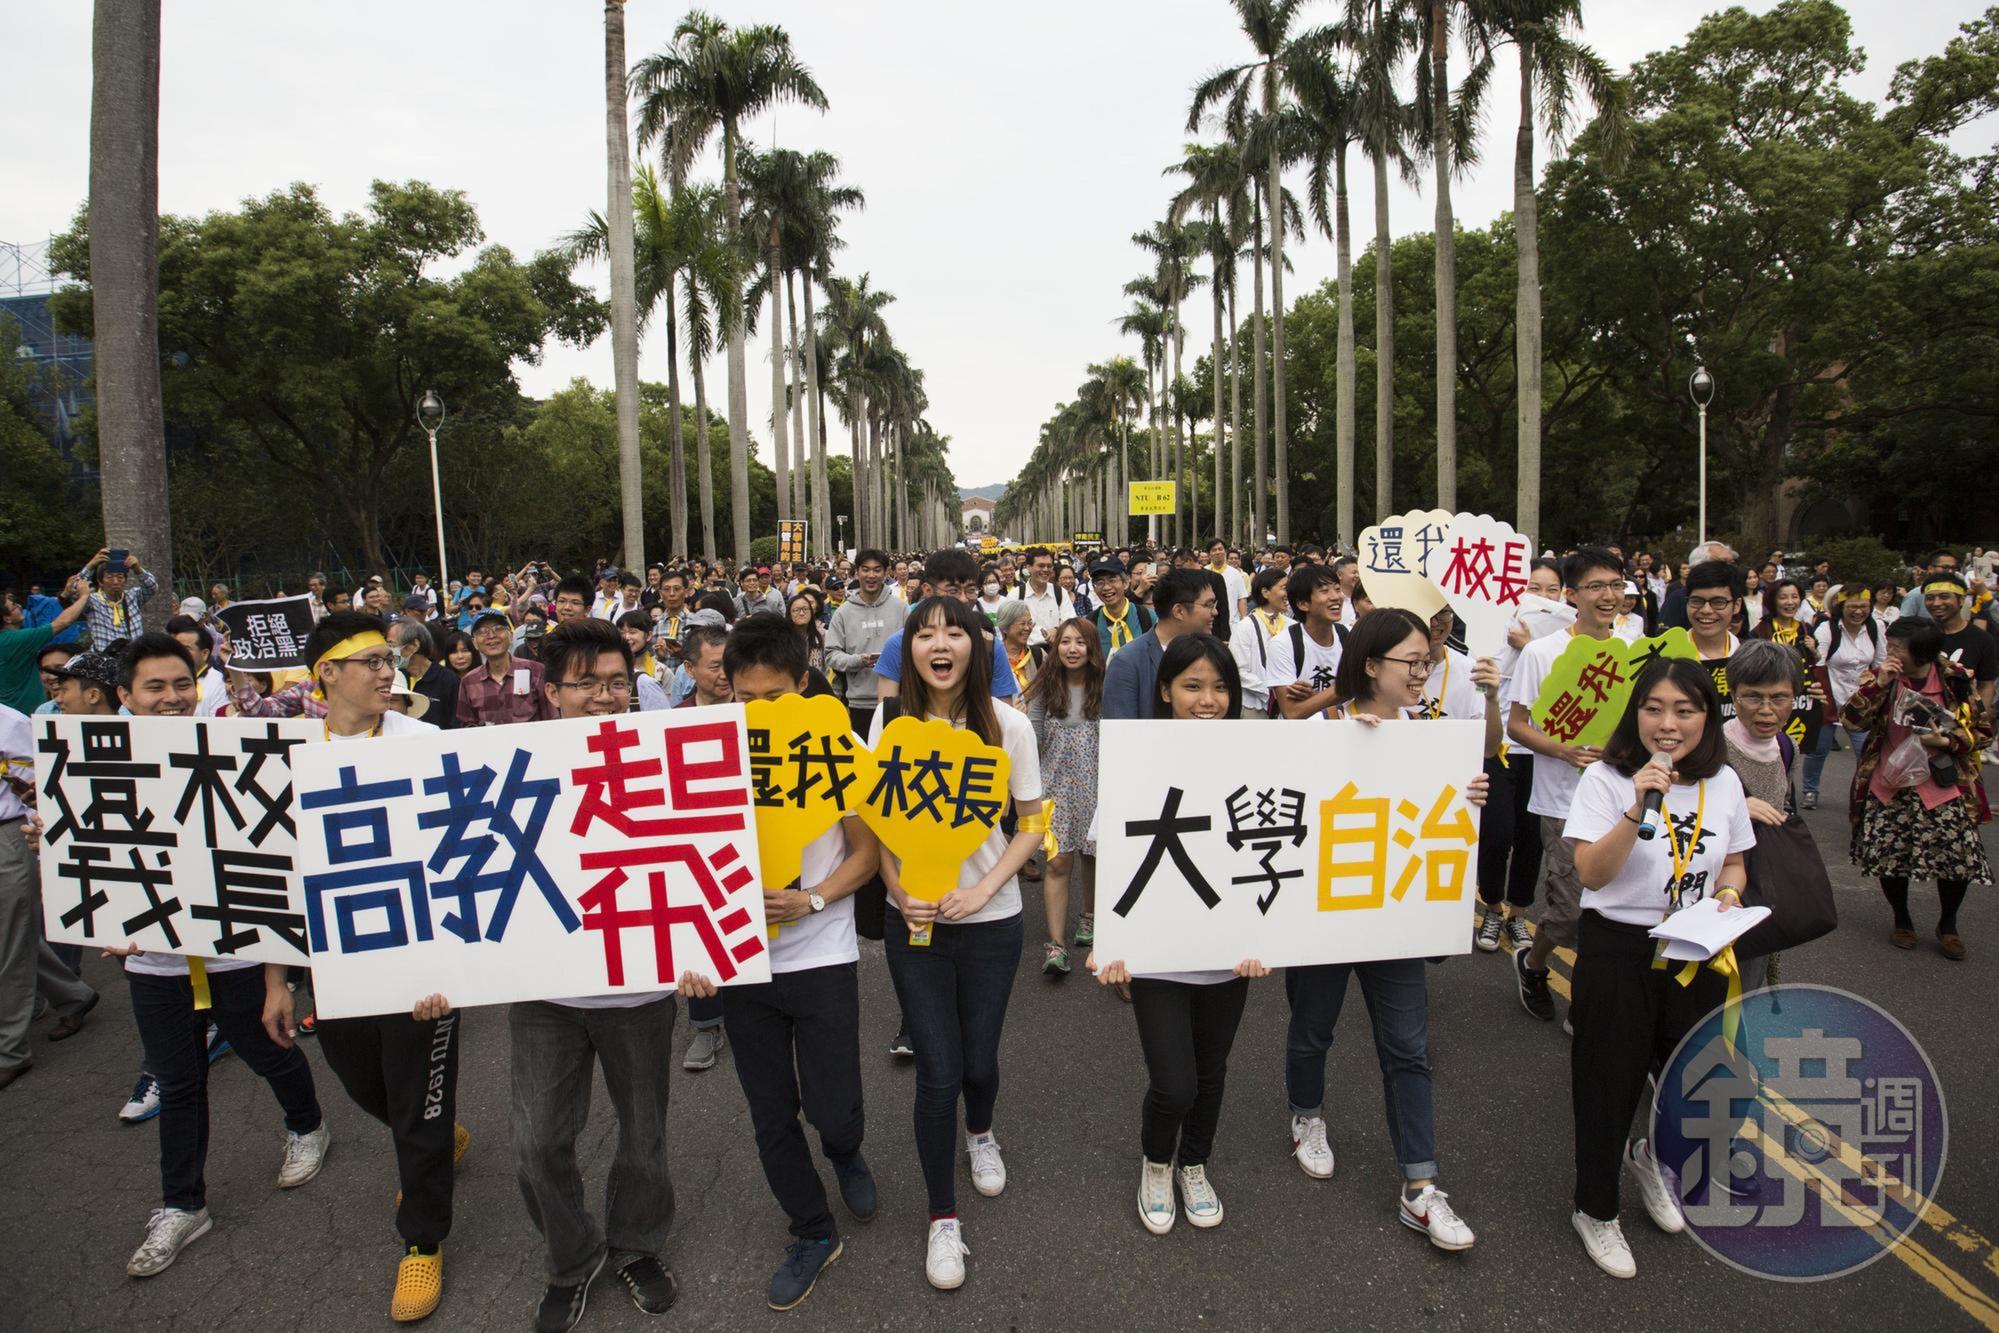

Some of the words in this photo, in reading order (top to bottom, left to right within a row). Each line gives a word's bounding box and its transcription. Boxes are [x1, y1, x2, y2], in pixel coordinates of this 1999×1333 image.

[792, 522, 803, 562] 大學自主
[1440, 537, 1528, 606] 校長
[246, 613, 291, 638] 拒絕
[1543, 651, 1625, 743] 還我
[866, 746, 1002, 829] 校長
[1112, 780, 1479, 918] 大學自治
[430, 1016, 456, 1062] NTU
[423, 1064, 445, 1120] 1928
